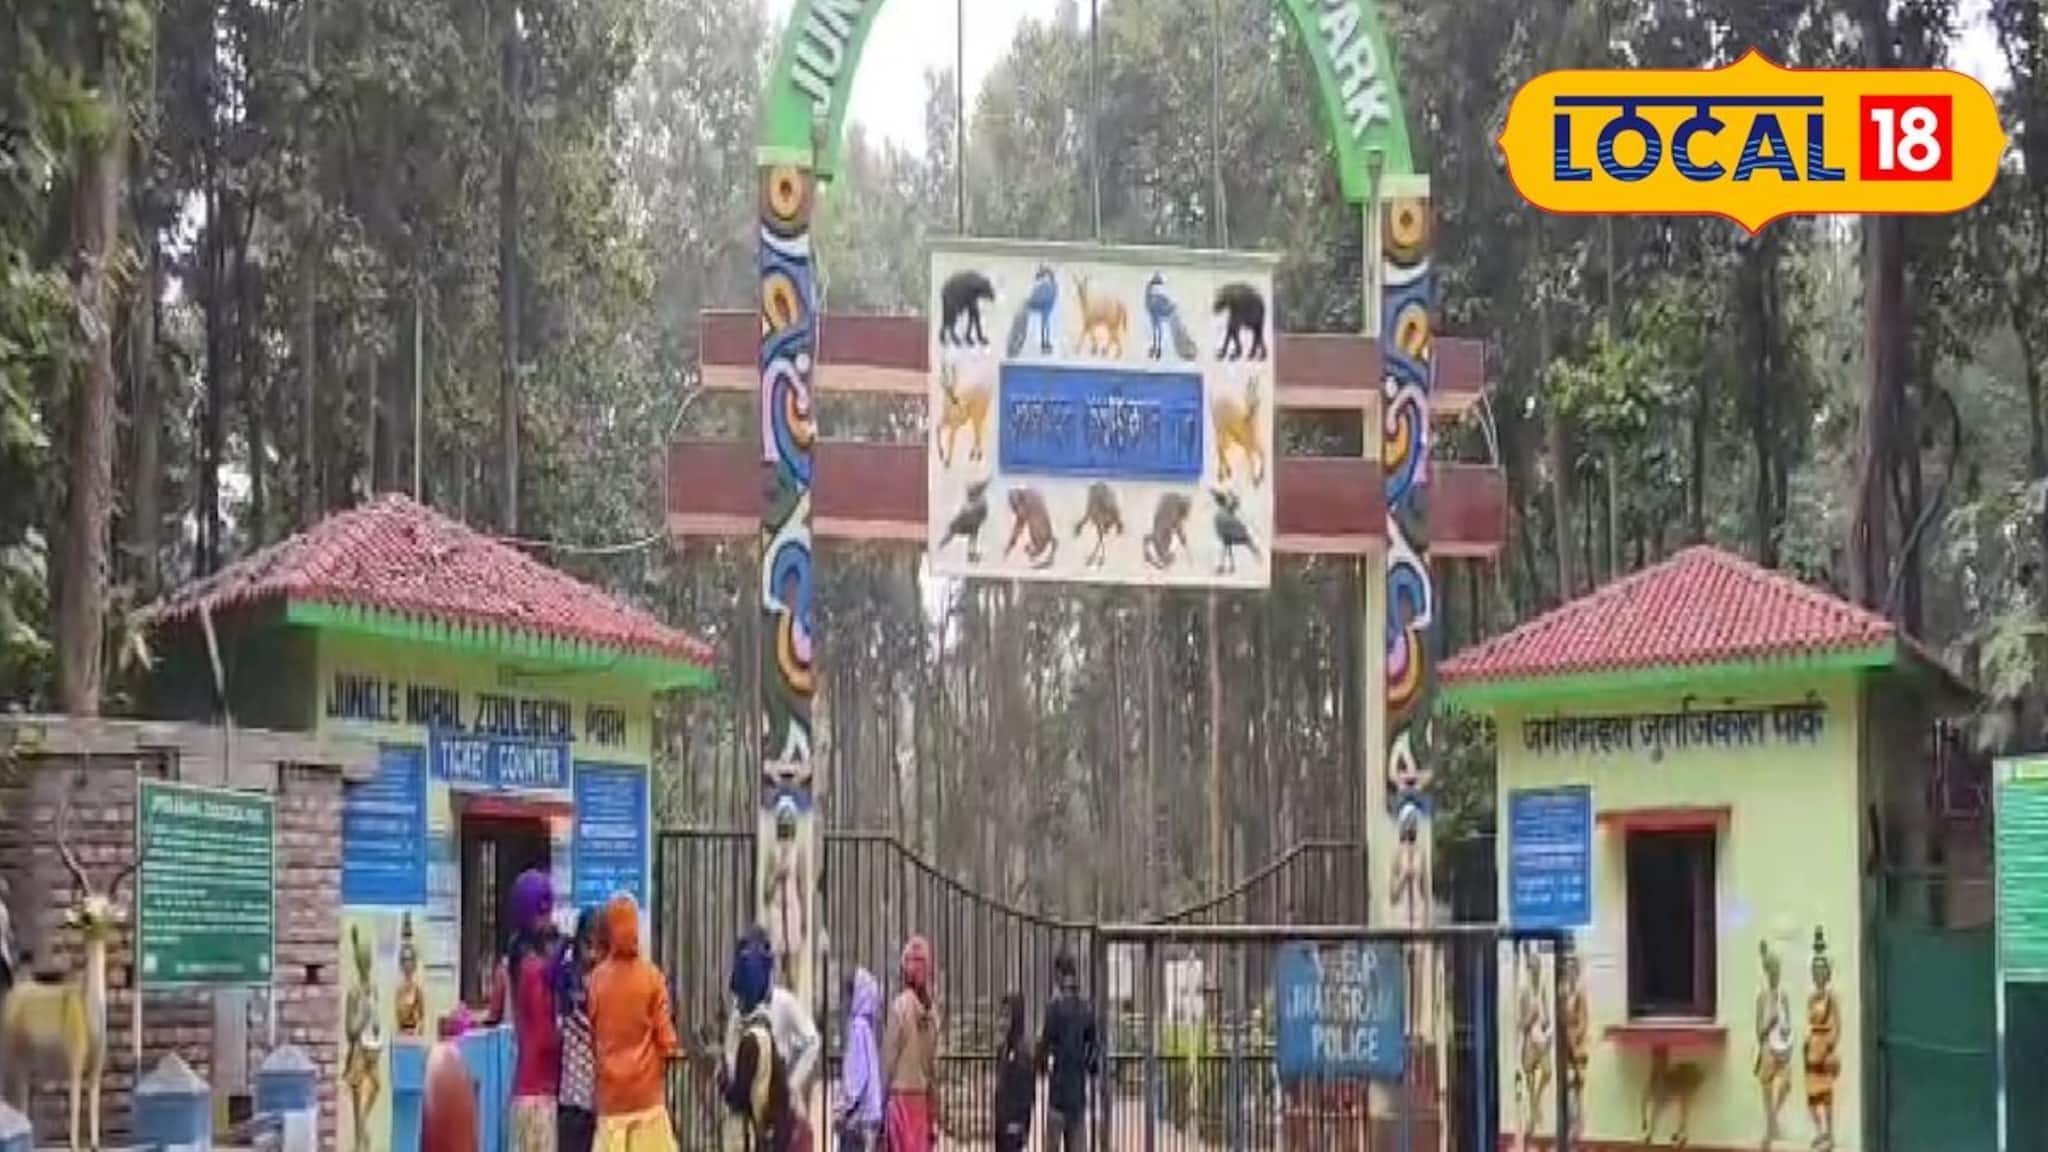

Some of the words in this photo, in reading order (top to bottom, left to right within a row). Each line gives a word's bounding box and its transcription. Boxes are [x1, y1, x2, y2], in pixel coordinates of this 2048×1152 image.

[439, 741, 489, 780] TICKET
[499, 744, 560, 785] COUNTER
[1311, 1023, 1381, 1063] POLICE
